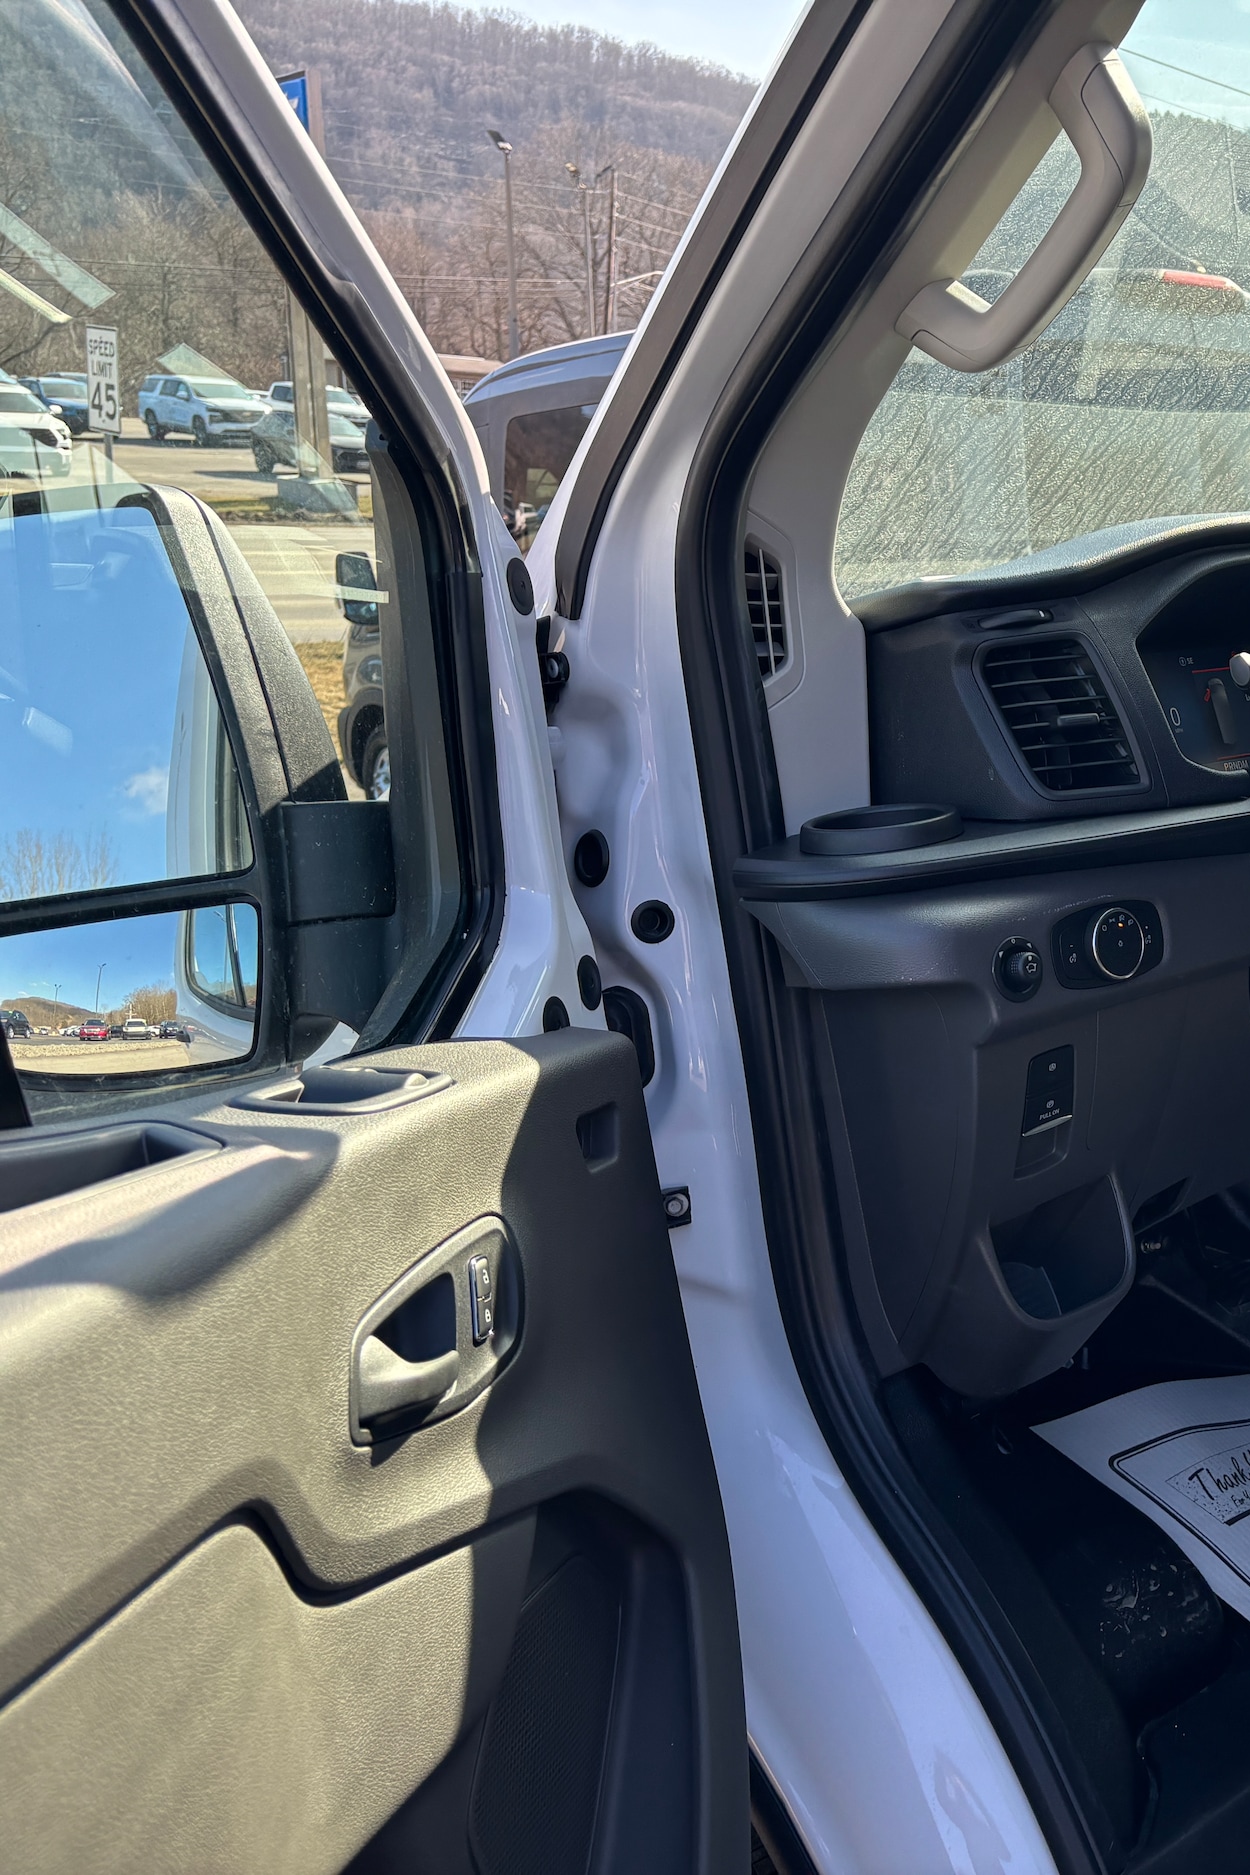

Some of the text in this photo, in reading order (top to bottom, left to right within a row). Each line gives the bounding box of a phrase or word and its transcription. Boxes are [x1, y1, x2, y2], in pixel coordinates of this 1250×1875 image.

[88, 338, 115, 358] SPEED
[91, 360, 113, 380] LIMIT
[91, 381, 117, 420] 45
[1039, 1111, 1052, 1120] PULL
